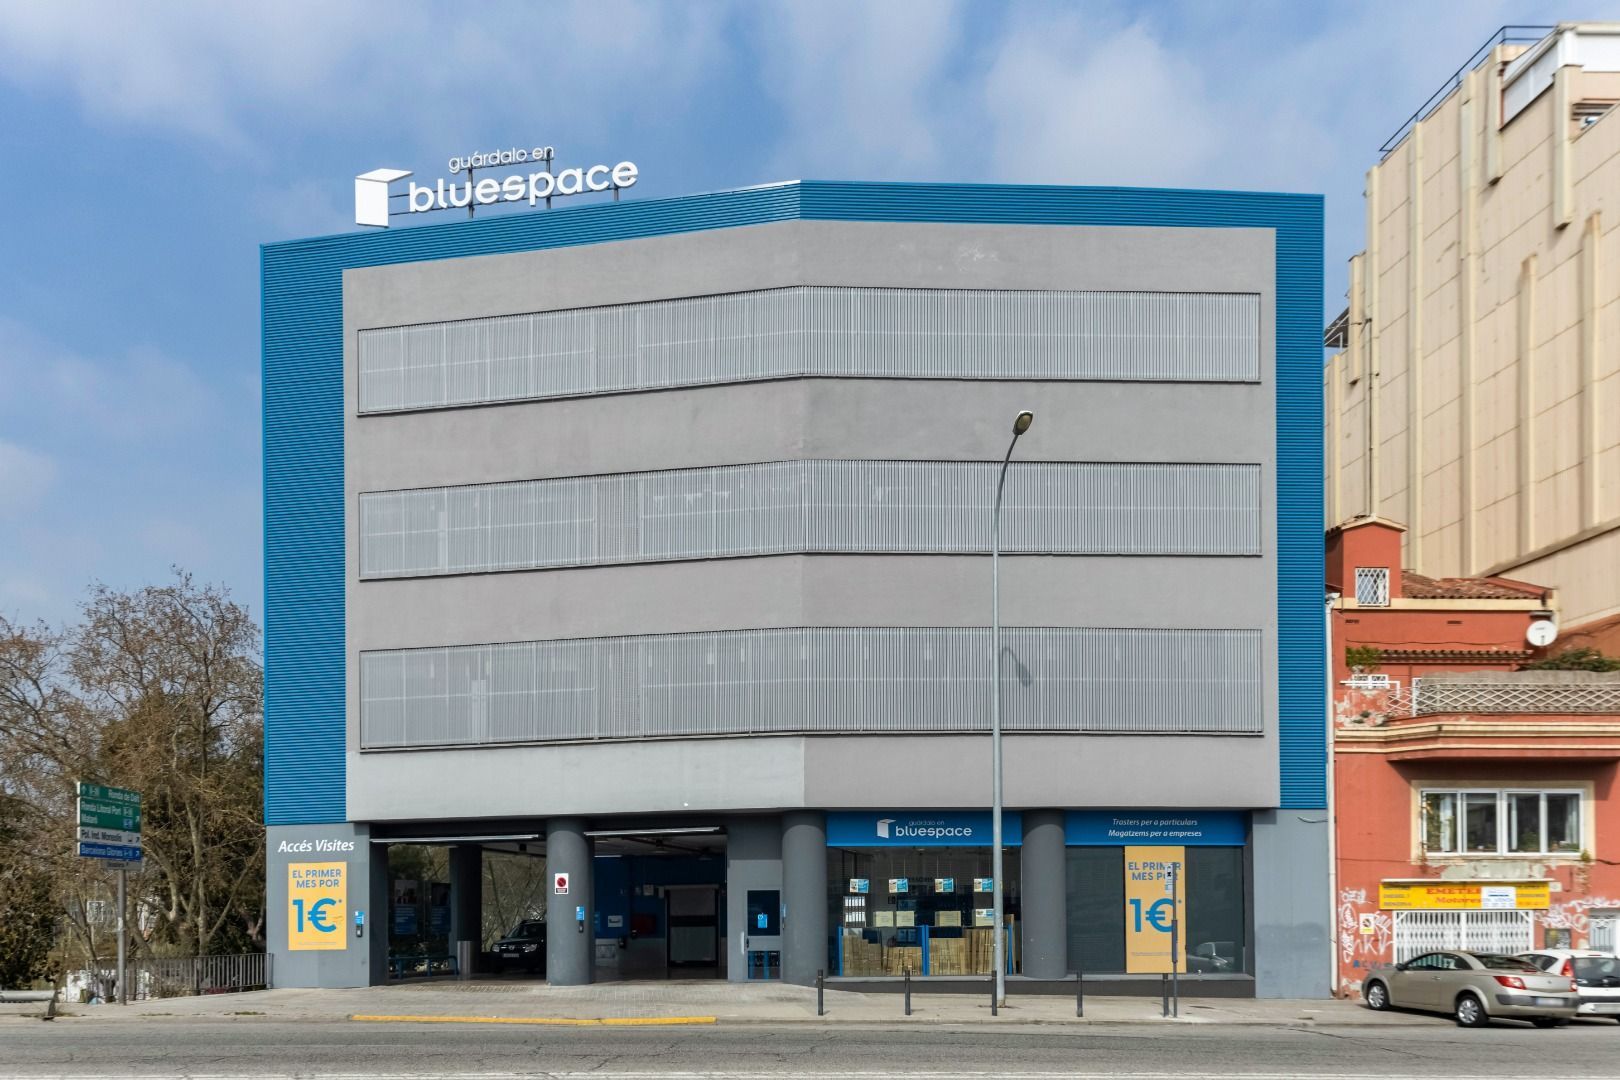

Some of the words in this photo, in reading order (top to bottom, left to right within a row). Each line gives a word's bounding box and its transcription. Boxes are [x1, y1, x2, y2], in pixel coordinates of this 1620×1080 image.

[448, 147, 527, 174] guárdalo
[532, 145, 554, 160] en
[409, 160, 639, 212] bluespace
[1113, 818, 1140, 826] Trasters
[1140, 819, 1153, 827] per
[1159, 818, 1198, 827] particulars
[895, 825, 973, 839] bluespace
[1108, 829, 1149, 838] Magatzems
[1149, 830, 1162, 838] per
[1169, 830, 1202, 838] empreses
[277, 839, 313, 853] Accés
[315, 839, 355, 852] Visites
[1128, 862, 1139, 870] EL
[292, 870, 303, 878] EL
[305, 869, 342, 878] PRIMER
[1132, 872, 1153, 880] MES
[296, 880, 317, 888] MES
[319, 879, 340, 888] POR
